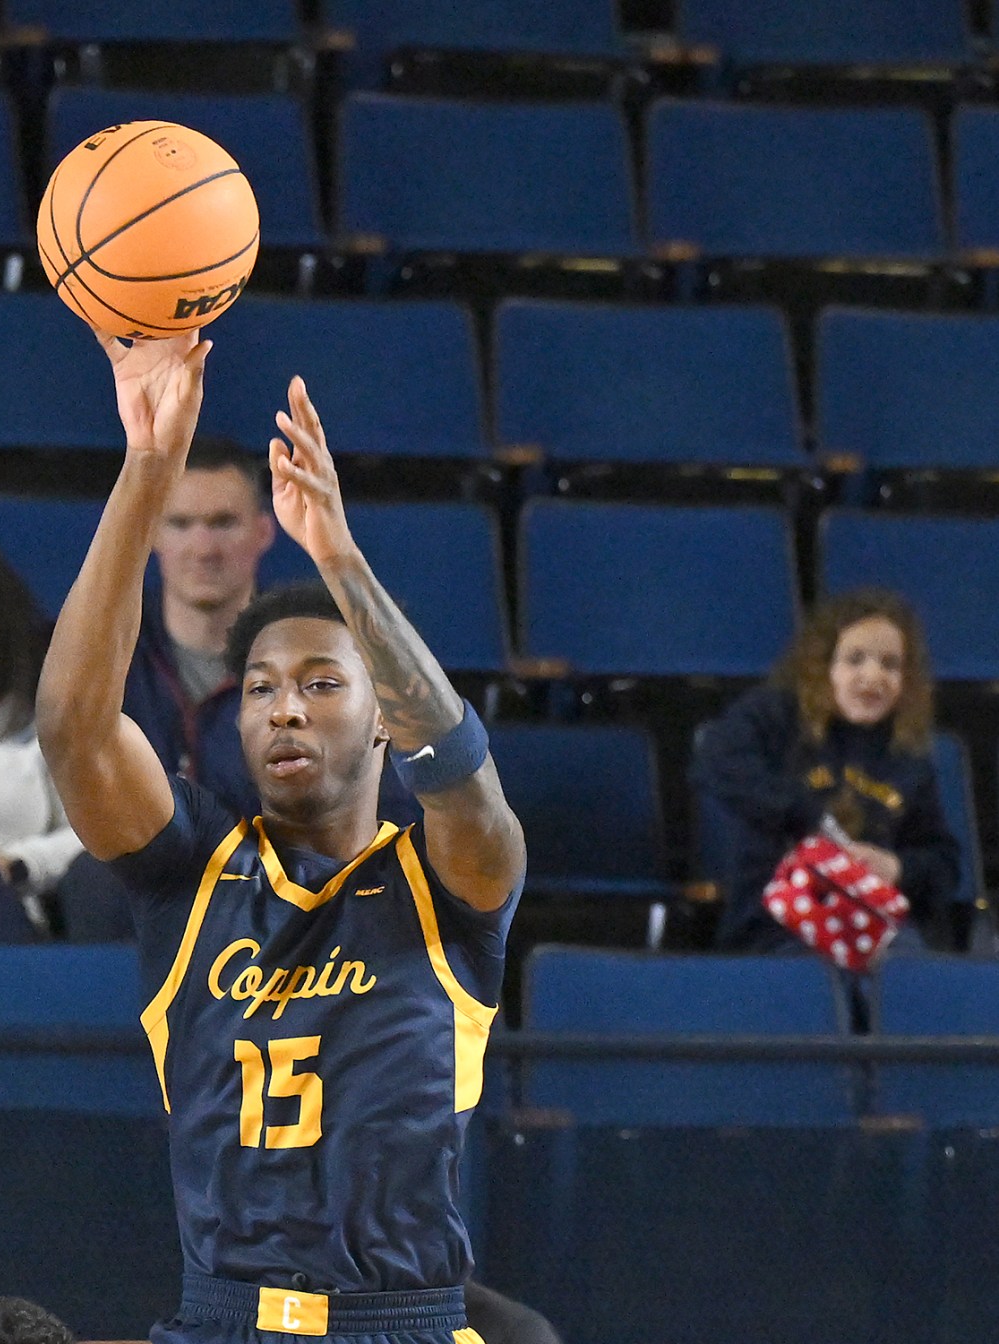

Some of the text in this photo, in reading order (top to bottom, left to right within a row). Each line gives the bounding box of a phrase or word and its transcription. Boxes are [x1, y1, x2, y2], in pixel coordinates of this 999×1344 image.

[208, 937, 377, 1020] Coppin
[233, 1035, 323, 1150] 15
[282, 1296, 301, 1329] C
